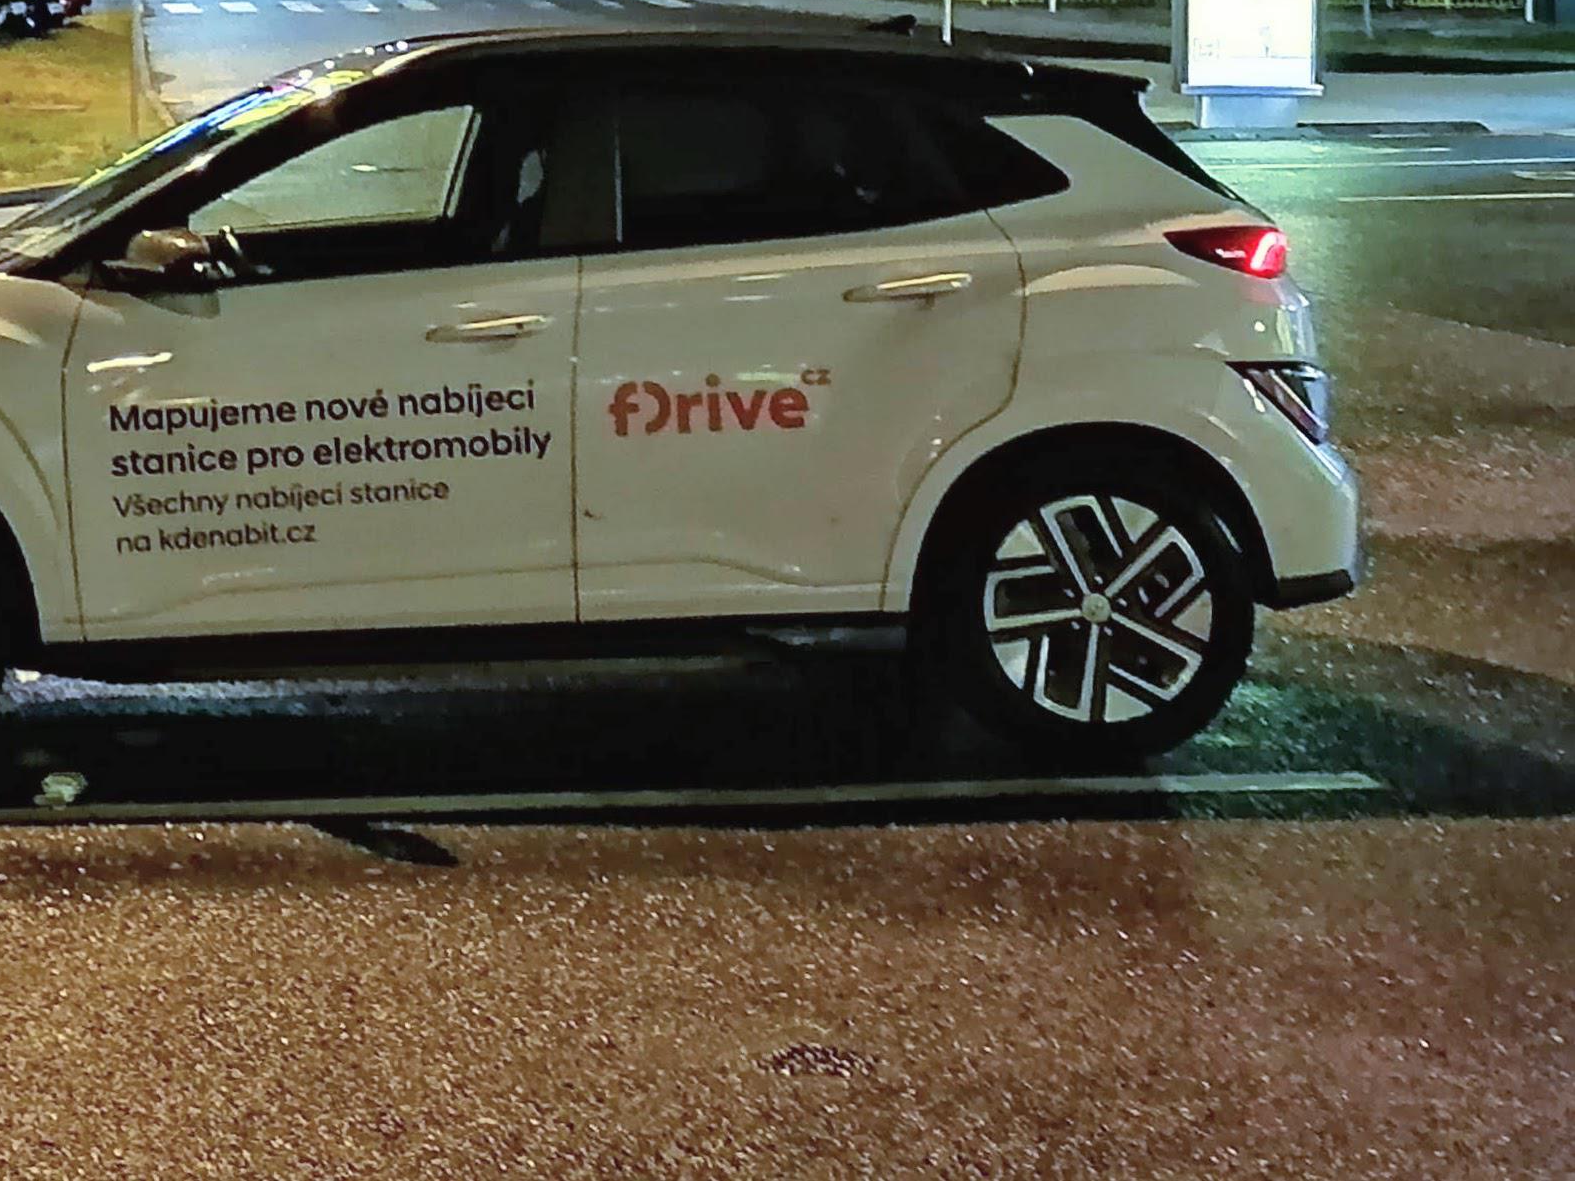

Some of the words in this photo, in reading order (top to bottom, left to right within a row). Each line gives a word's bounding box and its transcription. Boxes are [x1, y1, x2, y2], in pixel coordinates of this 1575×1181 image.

[109, 398, 297, 435] Mapujeme
[305, 388, 389, 421] nové
[111, 443, 238, 477] stanice
[247, 445, 304, 475] pro
[312, 426, 552, 466] elektromobily
[112, 490, 230, 518] Všechny
[350, 478, 451, 505] stanice
[116, 534, 152, 554] na
[159, 523, 317, 552] kdenabit.cz
